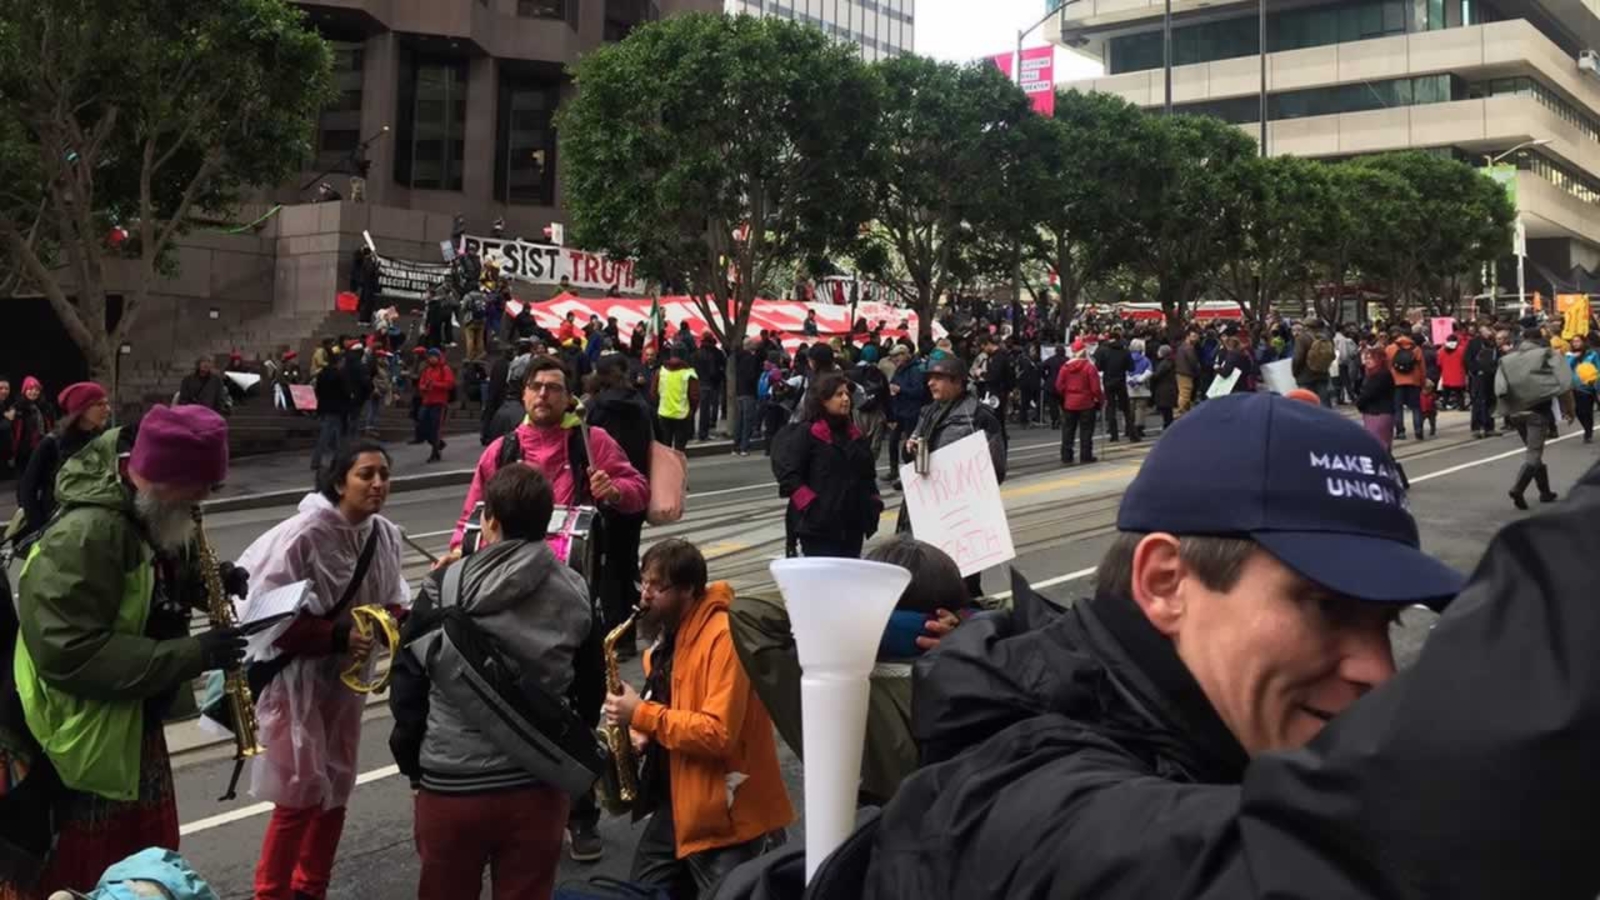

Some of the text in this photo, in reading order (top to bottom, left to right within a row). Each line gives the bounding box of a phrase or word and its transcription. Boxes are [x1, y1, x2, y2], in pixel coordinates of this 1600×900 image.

[907, 441, 990, 507] TRUMP
[1310, 451, 1375, 475] MAKE
[1327, 478, 1397, 503] UNION
